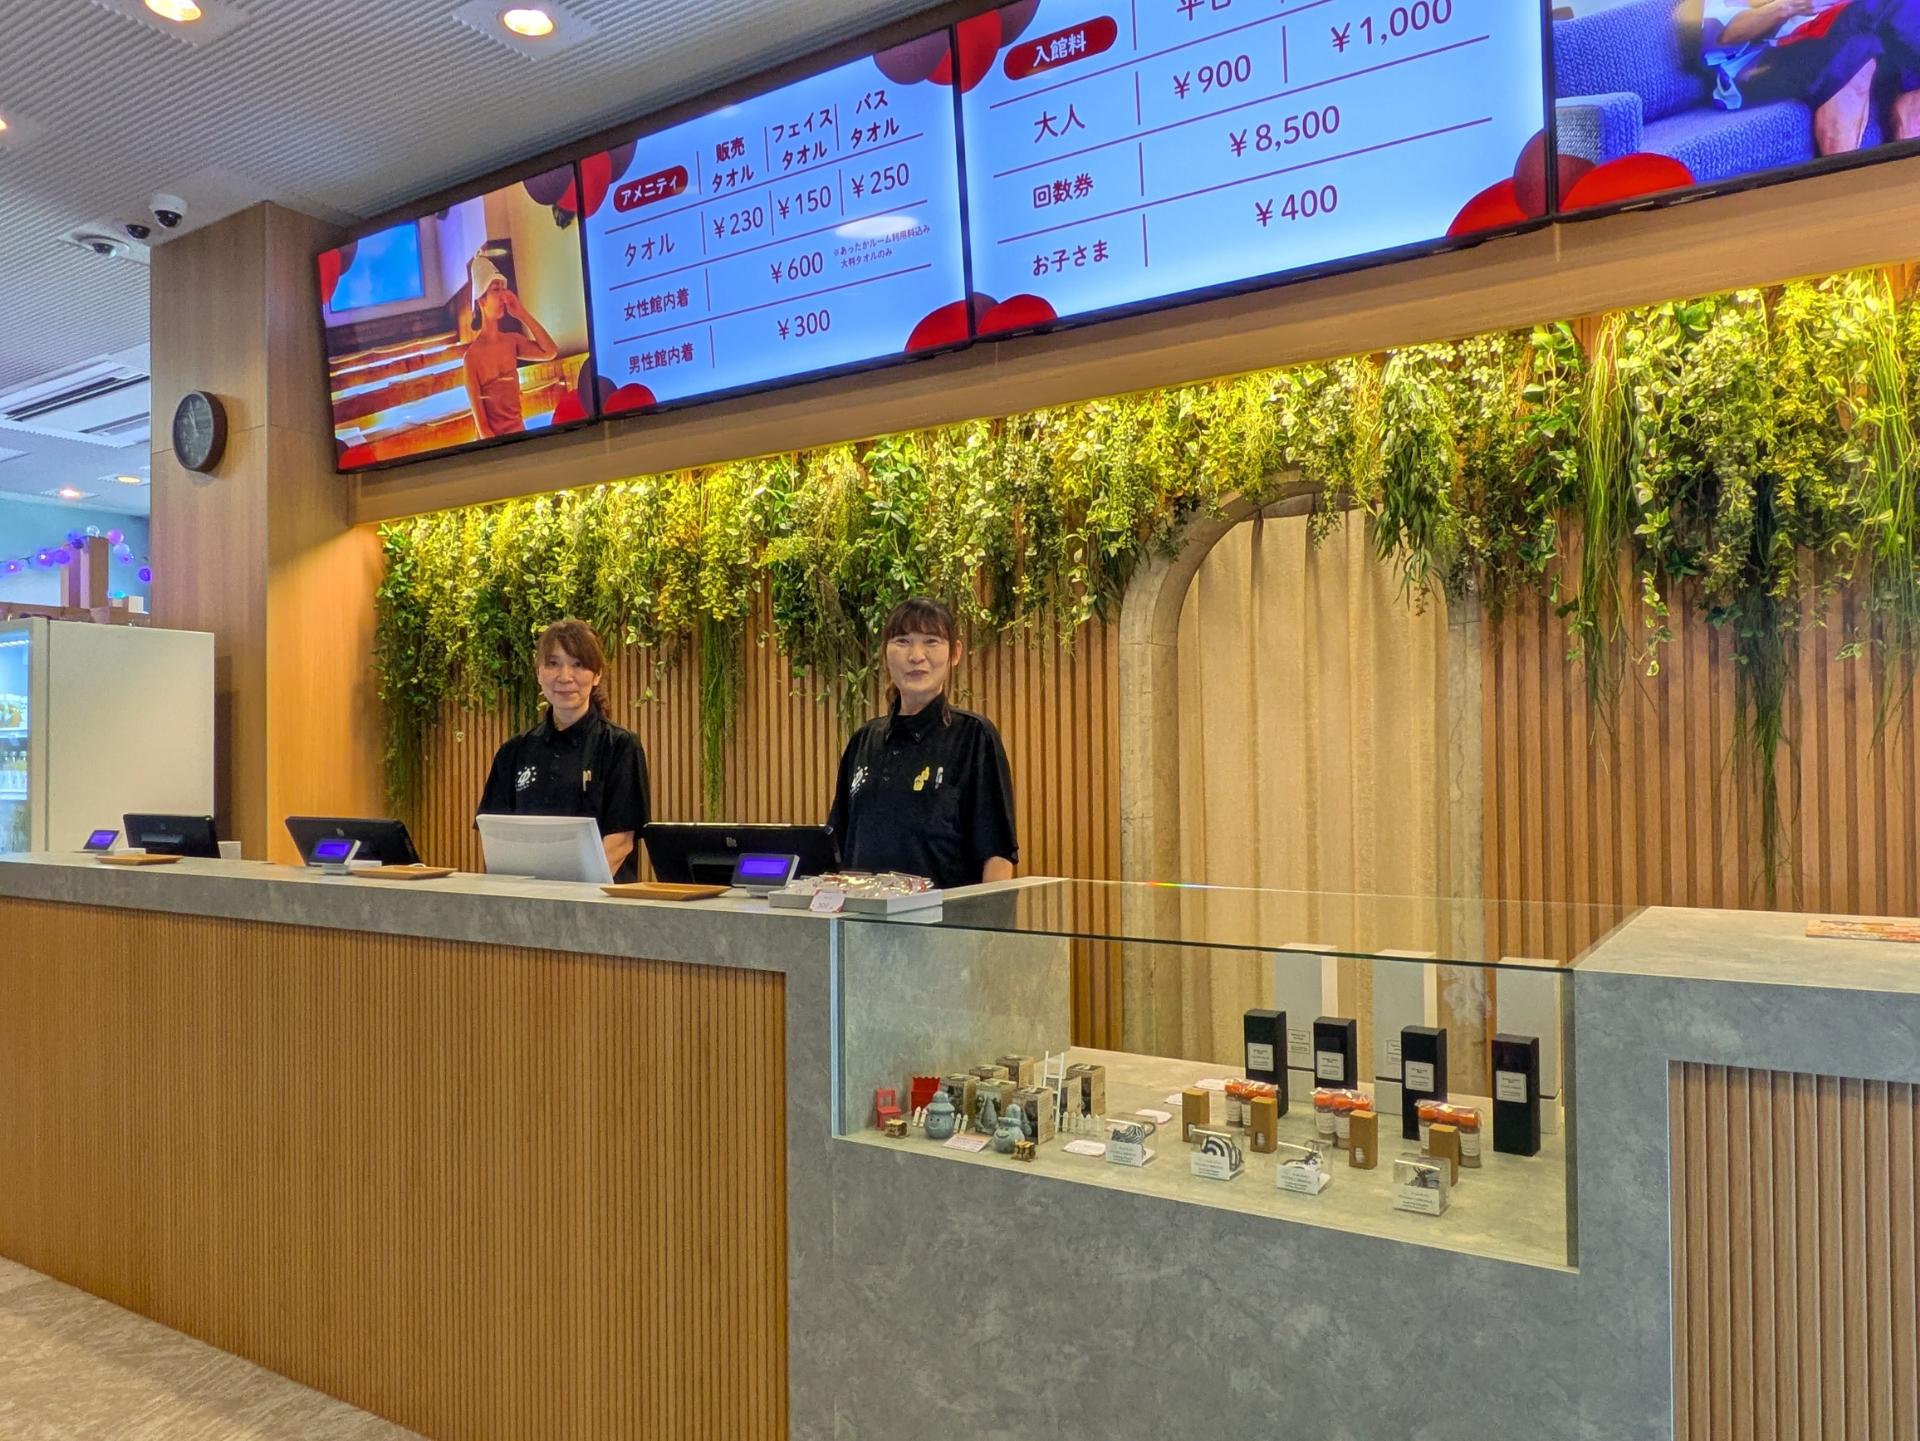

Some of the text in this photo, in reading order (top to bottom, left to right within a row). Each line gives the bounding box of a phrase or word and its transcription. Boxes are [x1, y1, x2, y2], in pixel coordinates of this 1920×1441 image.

[1331, 0, 1451, 53] ¥1,000
[1032, 30, 1087, 66] 入館料
[1173, 55, 1251, 99] ¥900
[856, 90, 888, 114] バス
[772, 108, 833, 143] フェイス
[850, 117, 900, 150] タオル
[1034, 104, 1085, 143] 大人
[1229, 106, 1340, 158] ¥8,500
[716, 137, 745, 163] 販売
[782, 141, 828, 171] タオル
[620, 175, 678, 206] アメニティ
[712, 167, 755, 193] タオル
[852, 163, 909, 198] ¥250
[1033, 173, 1093, 208] 回数券
[778, 186, 831, 219] ¥150
[1254, 184, 1338, 227] ¥400
[714, 207, 763, 238] ¥230
[624, 233, 676, 268] タオル
[771, 252, 823, 283] ¥600
[1032, 239, 1109, 276] お子さま
[624, 288, 690, 322] 女性館内着
[777, 310, 830, 340] ¥300
[629, 343, 694, 374] 男性館内着
